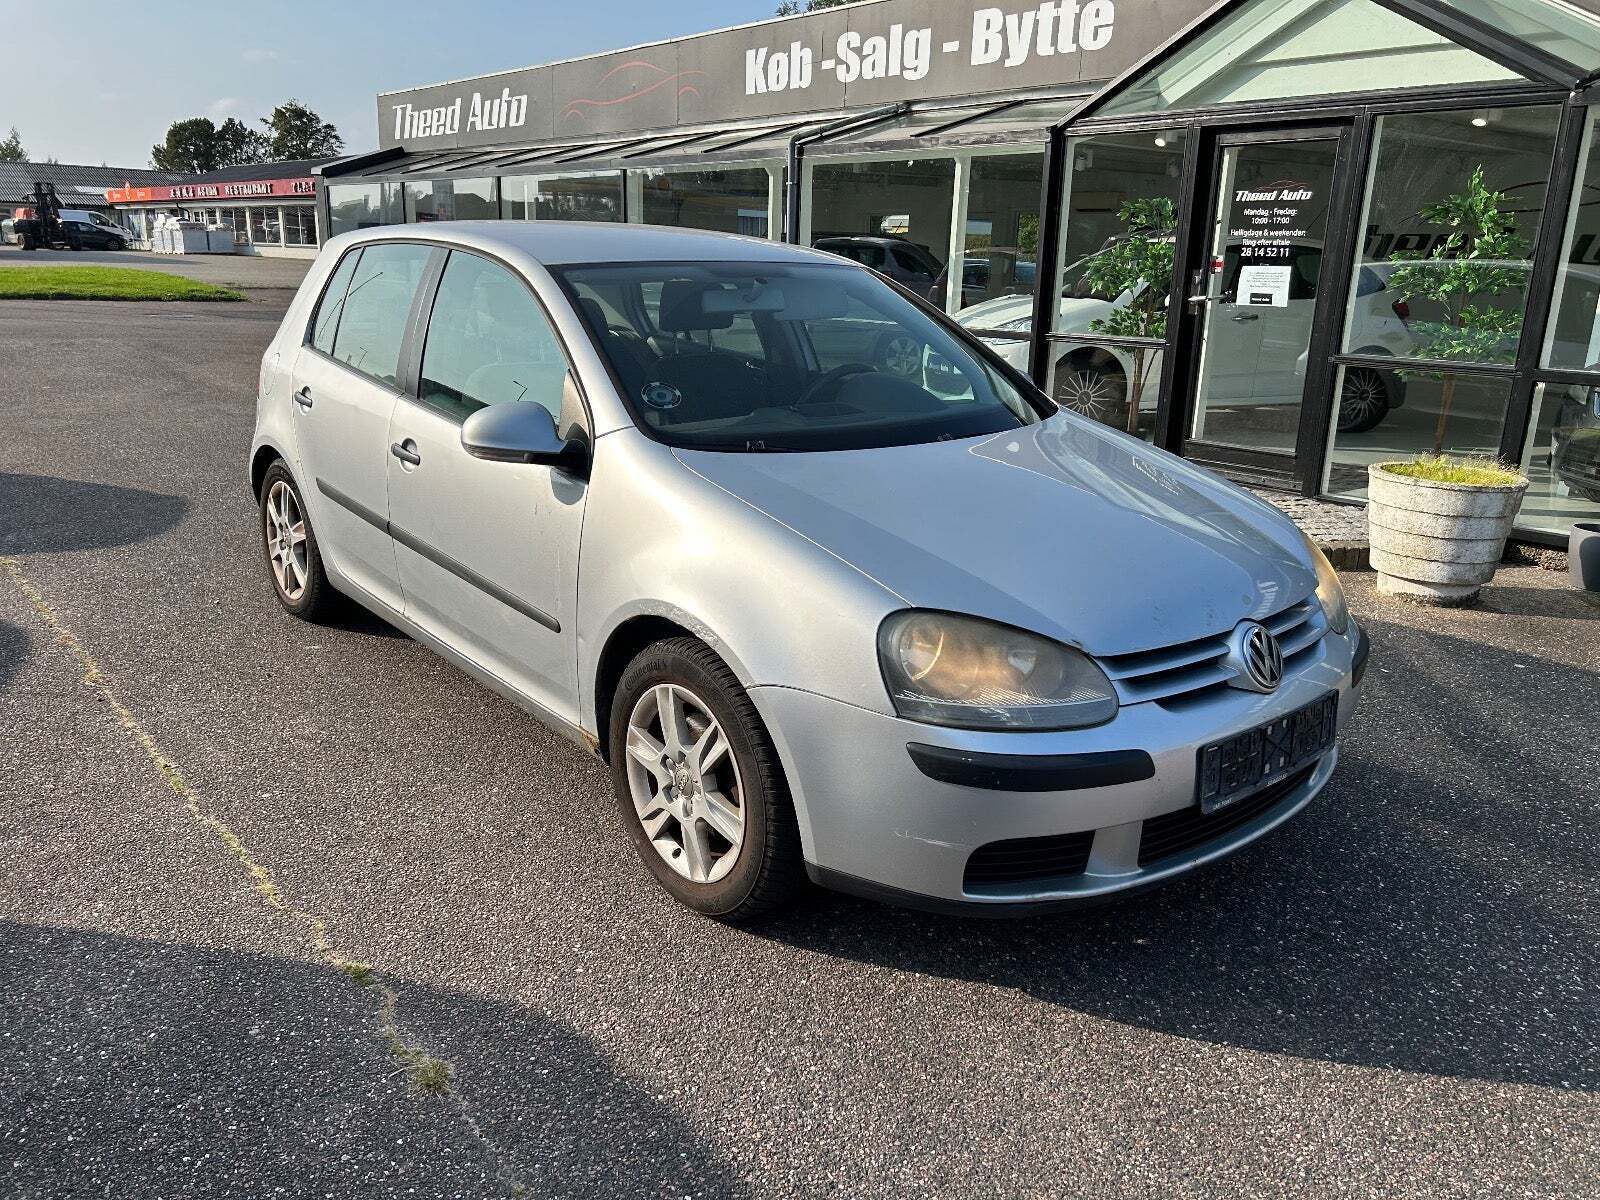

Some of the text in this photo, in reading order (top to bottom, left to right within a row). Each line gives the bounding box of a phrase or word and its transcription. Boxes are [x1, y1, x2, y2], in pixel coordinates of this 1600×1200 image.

[745, 41, 812, 95] Køb
[970, 0, 1115, 67] Bytte
[392, 88, 528, 140] Theed Auto
[224, 183, 272, 195] RESTAURANT
[1235, 189, 1313, 202] Theed Auto
[1243, 208, 1269, 217] Mandag
[1273, 208, 1298, 217] Fredag:
[1242, 239, 1256, 247] Ring
[1240, 247, 1290, 257] 28 14 52 11
